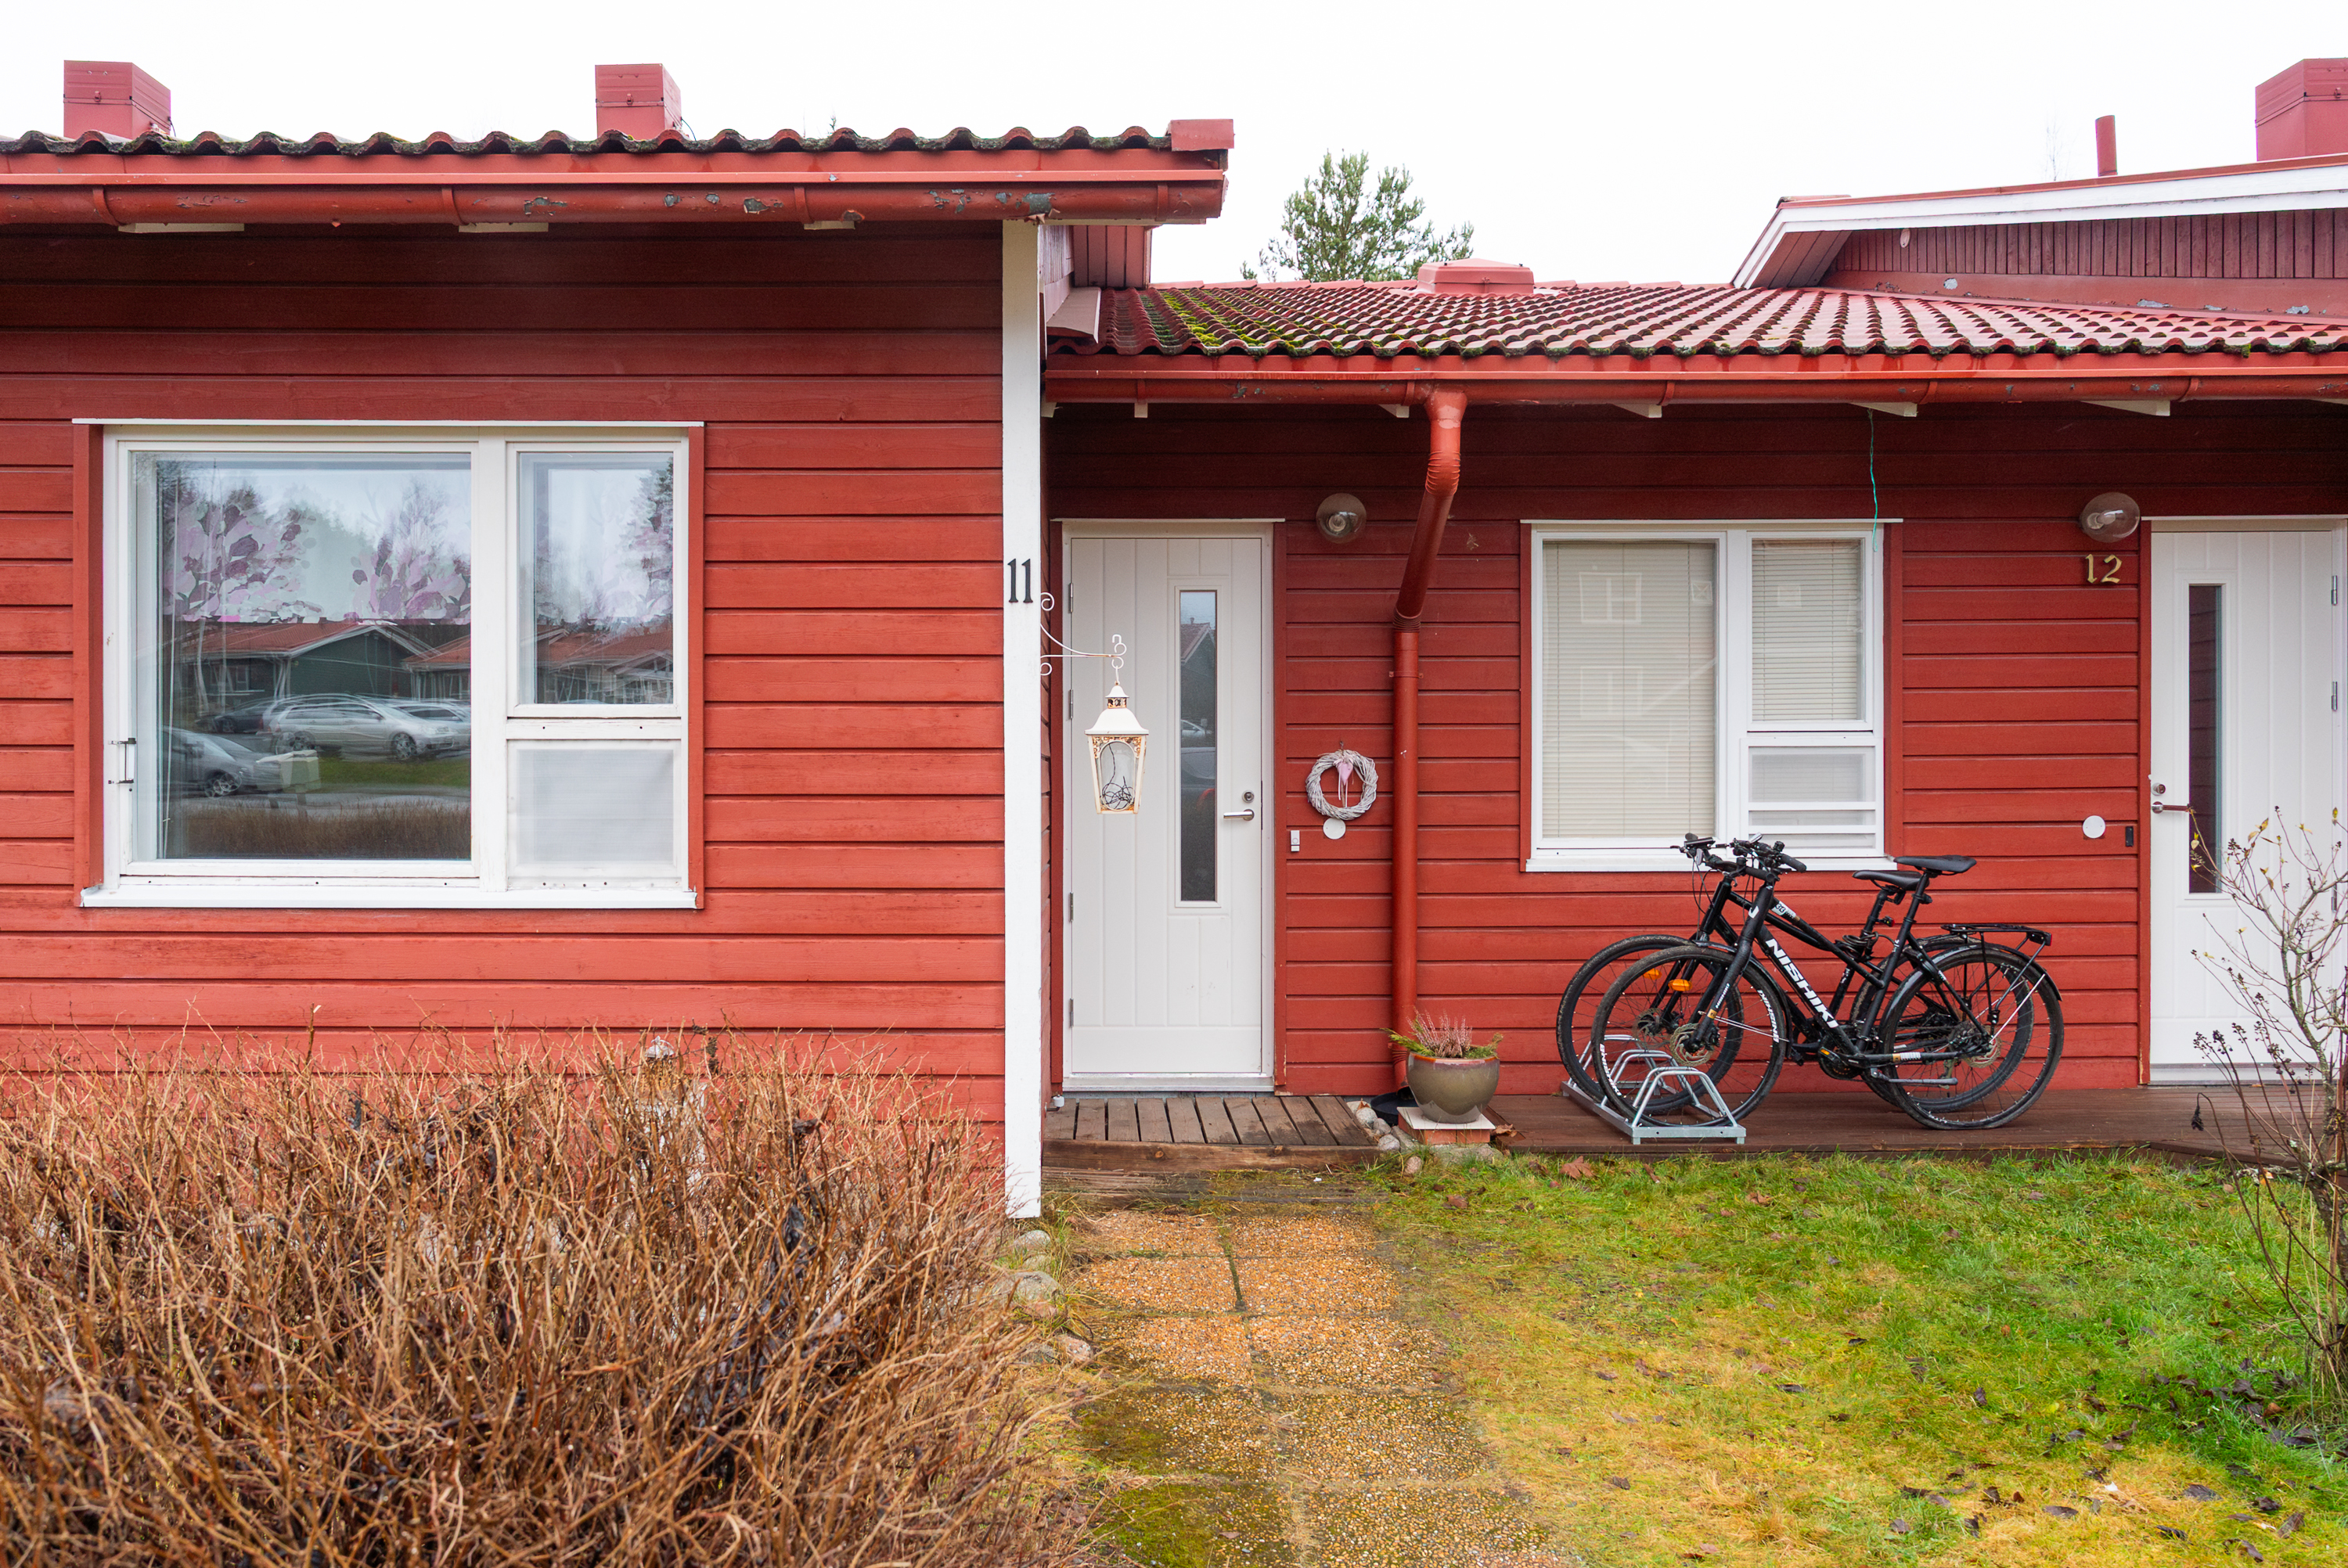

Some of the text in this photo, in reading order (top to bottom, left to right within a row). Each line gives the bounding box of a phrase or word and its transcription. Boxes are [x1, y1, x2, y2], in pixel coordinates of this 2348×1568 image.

[1007, 558, 1033, 602] 11
[2085, 554, 2123, 584] 12
[1766, 938, 1838, 1028] NISHIKI
